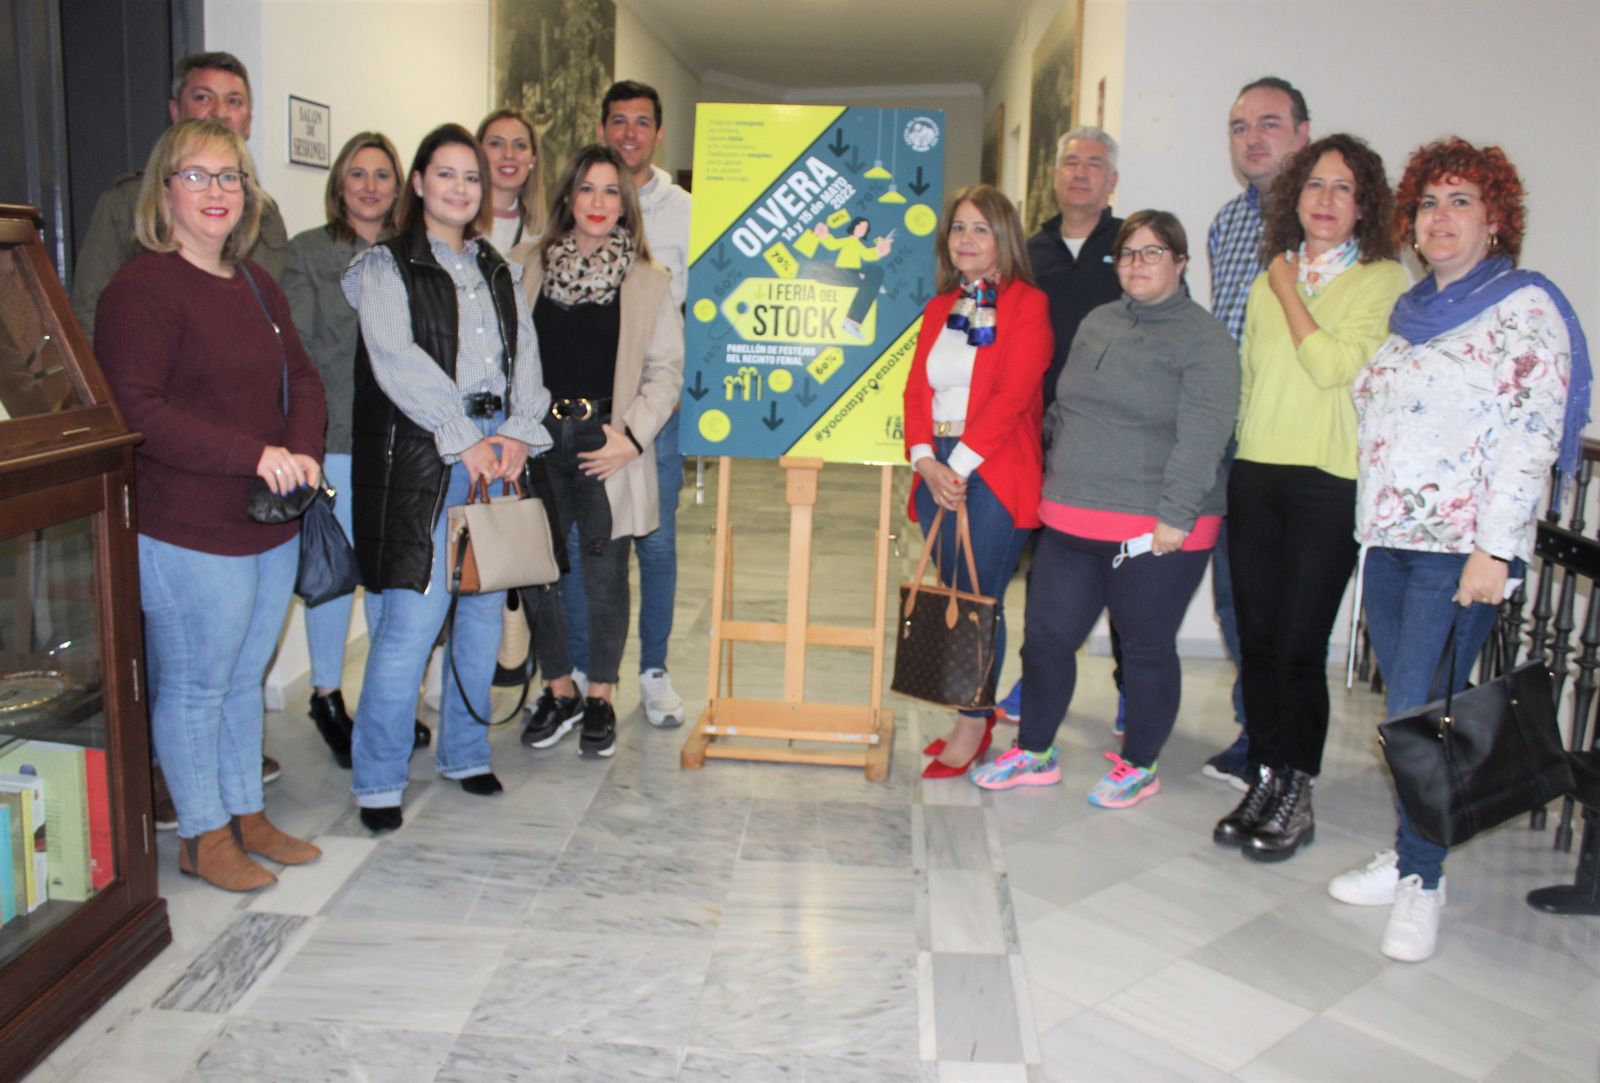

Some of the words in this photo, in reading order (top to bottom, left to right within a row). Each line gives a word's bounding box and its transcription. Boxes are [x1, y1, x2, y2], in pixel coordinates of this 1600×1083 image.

[294, 137, 326, 161] SESIONES
[731, 156, 838, 258] OLVERA
[781, 226, 797, 241] 14
[793, 221, 804, 234] y
[799, 210, 813, 224] 15
[810, 200, 825, 215] de
[820, 176, 848, 204] MAYO
[830, 184, 857, 210] 2022
[770, 250, 792, 272] 70%
[776, 284, 816, 302] FERIA
[820, 289, 839, 303] DEL
[753, 304, 838, 339] STOCK
[726, 353, 740, 363] DEL
[742, 354, 775, 365] RECINTO
[775, 355, 803, 366] FERIAL
[767, 345, 778, 355] DE
[815, 354, 837, 375] 60%
